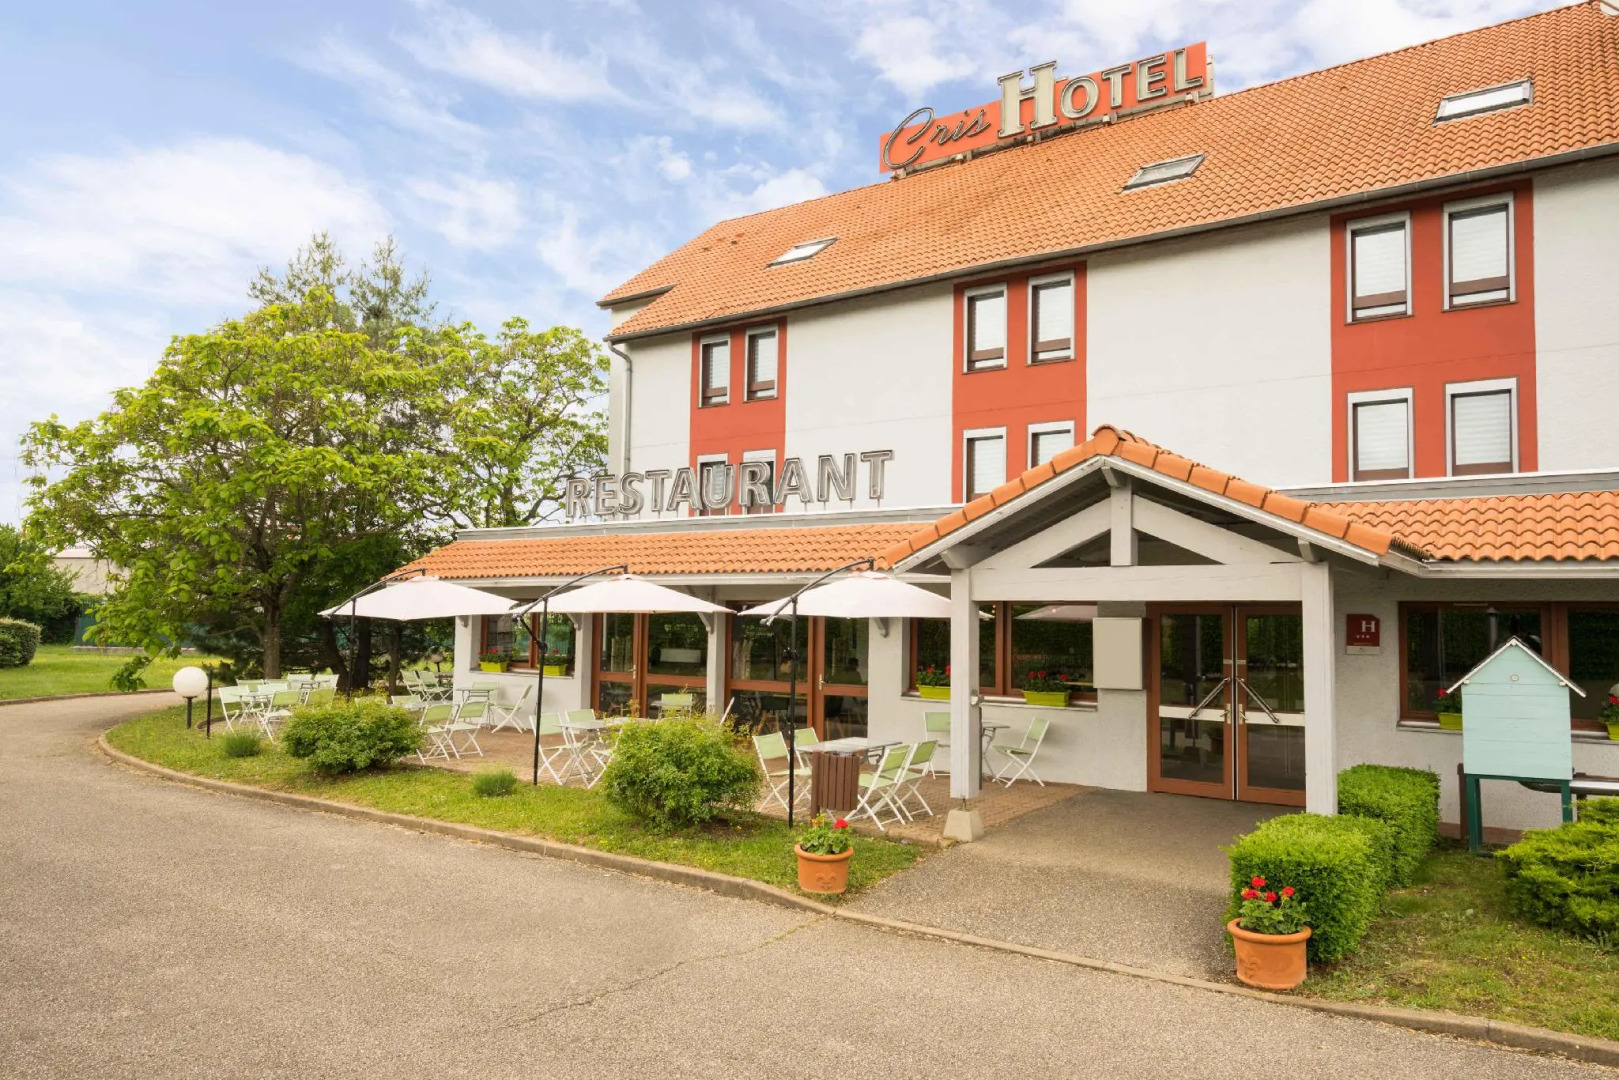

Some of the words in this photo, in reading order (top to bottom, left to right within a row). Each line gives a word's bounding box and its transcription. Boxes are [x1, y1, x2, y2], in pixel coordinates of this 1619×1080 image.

[882, 106, 991, 169] Cris
[998, 48, 1204, 138] HOTEL
[566, 449, 894, 518] RESTAURANT
[1361, 620, 1376, 633] H
